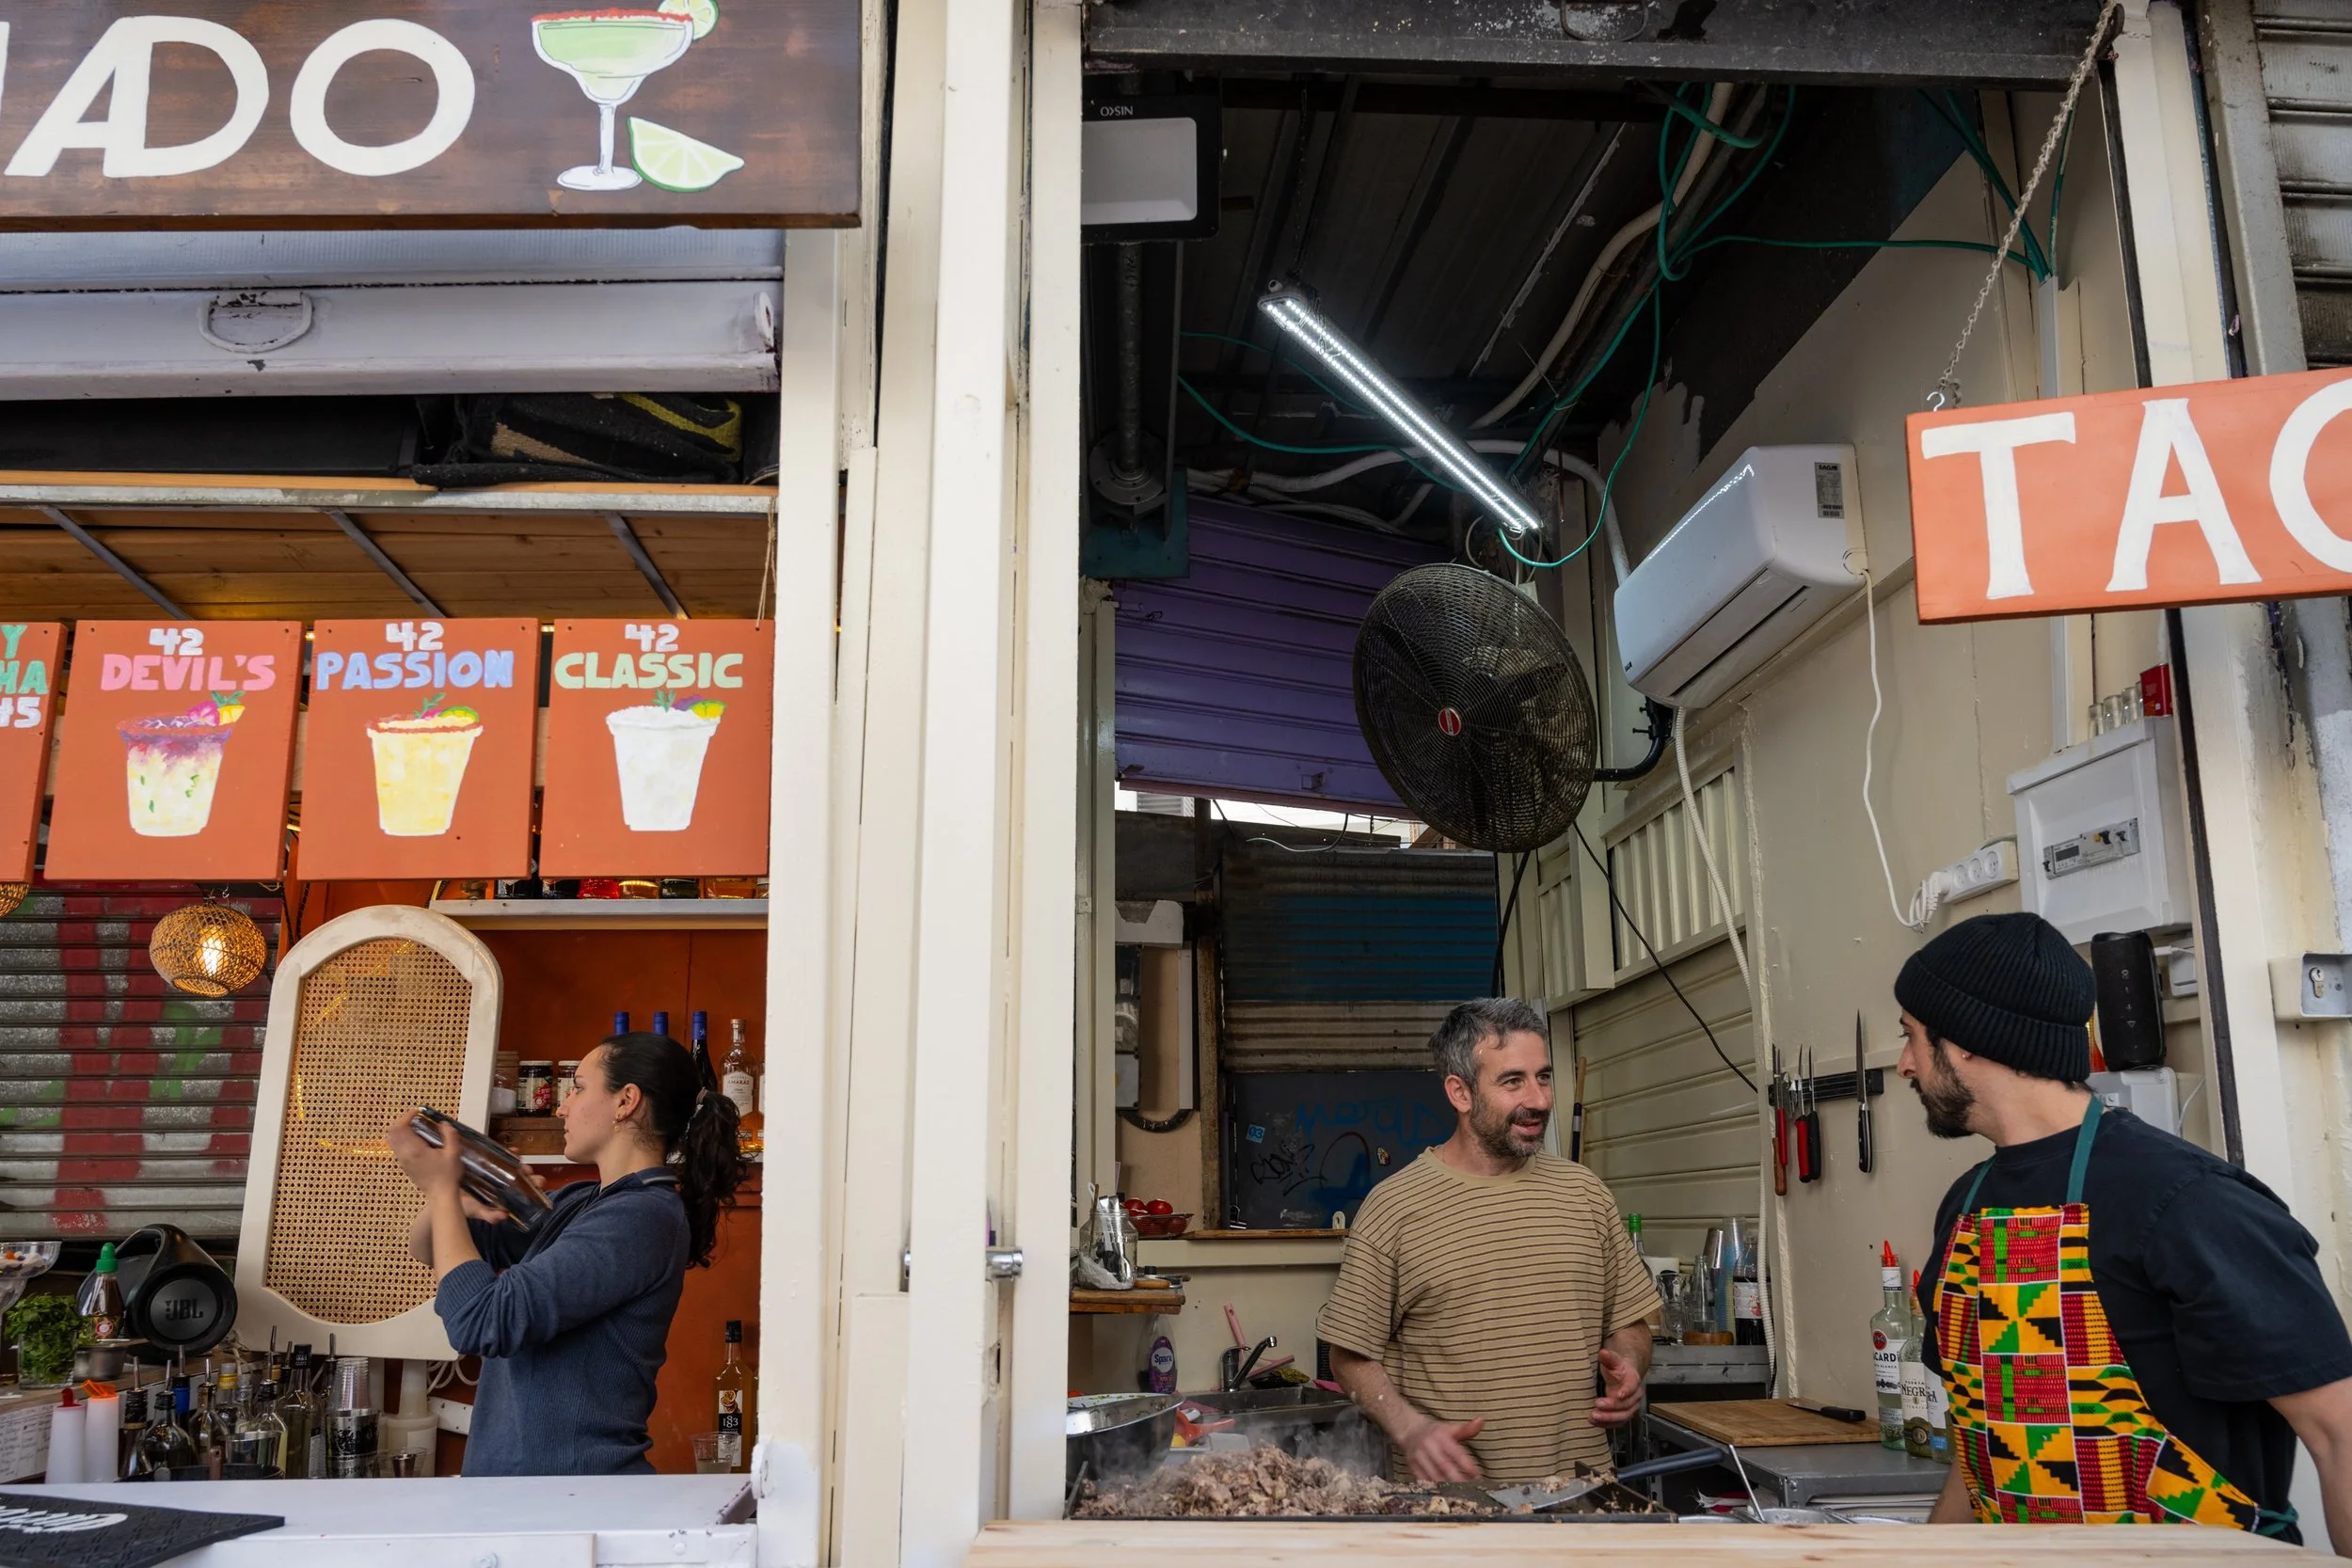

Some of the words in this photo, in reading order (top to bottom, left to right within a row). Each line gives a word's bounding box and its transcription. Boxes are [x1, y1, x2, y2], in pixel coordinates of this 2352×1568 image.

[0, 15, 476, 179] ADO
[149, 627, 204, 656] 42
[386, 621, 445, 651] 42
[624, 623, 679, 652] 42
[101, 654, 276, 691] DEVIL'S
[317, 650, 515, 690] PASSION
[554, 652, 743, 689] CLASSIC
[165, 1298, 204, 1321] JBL
